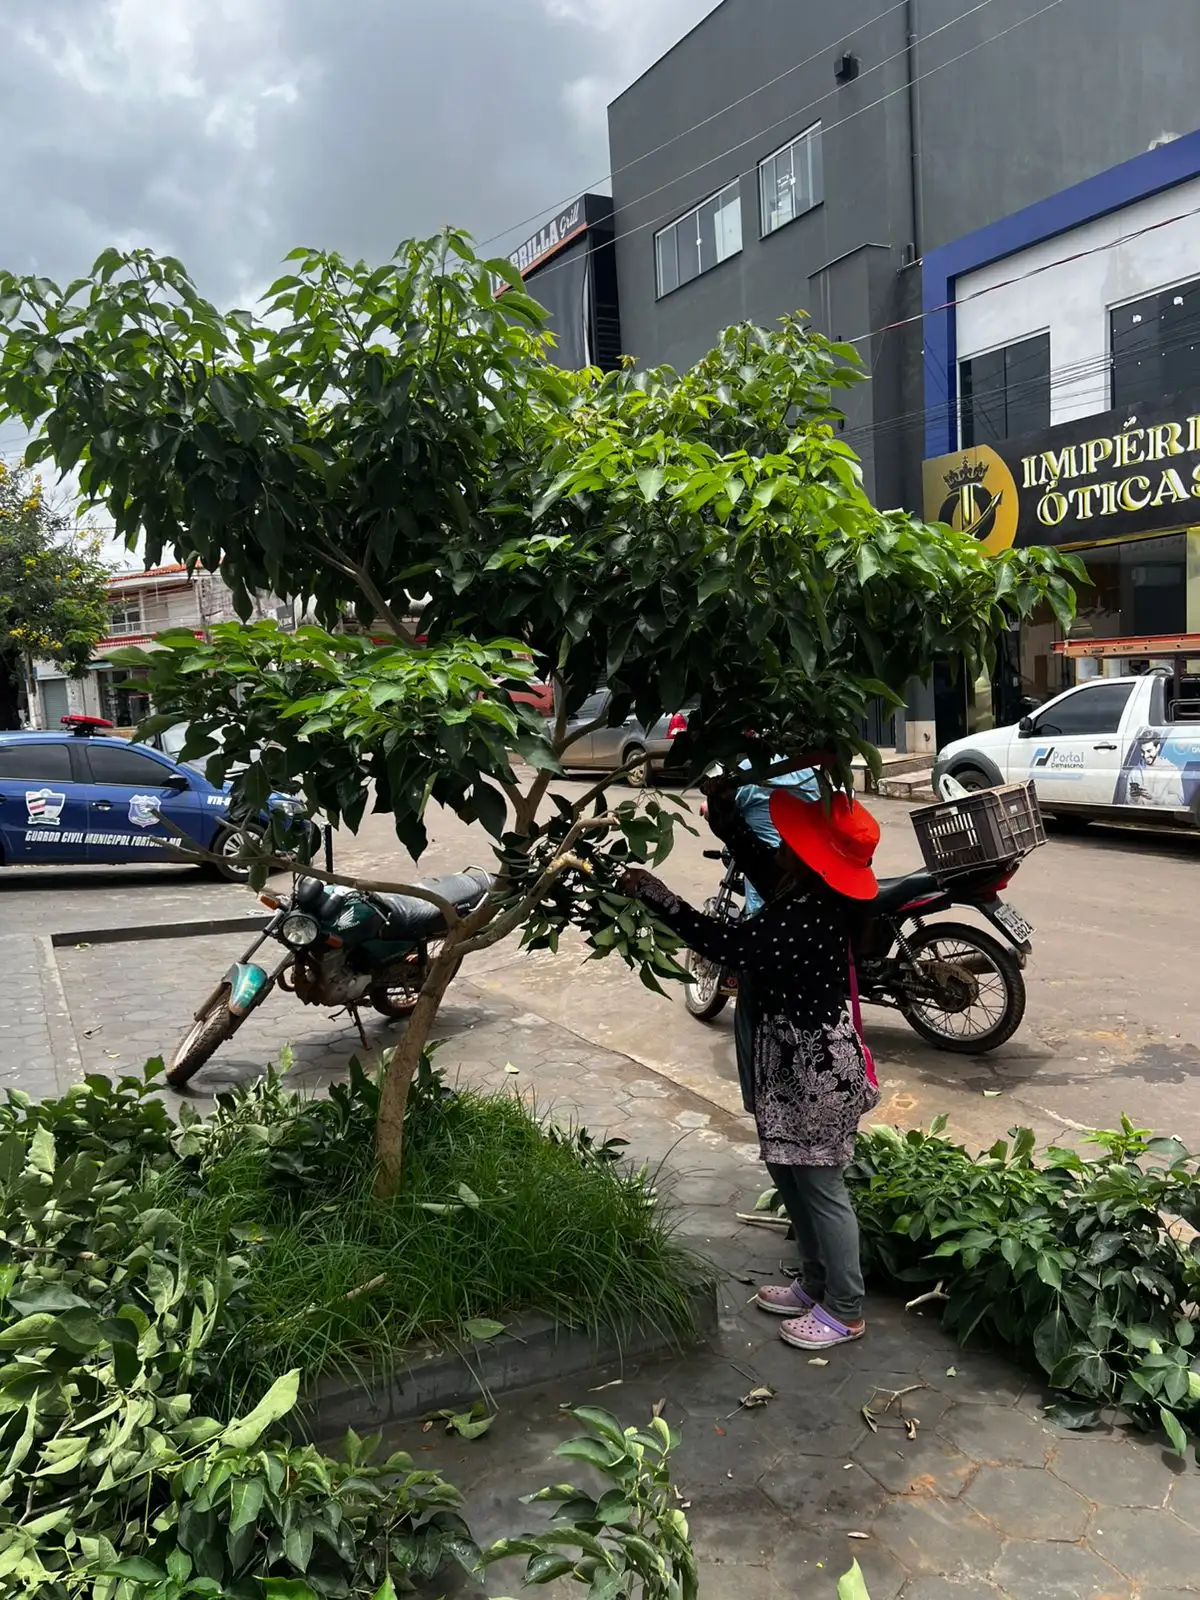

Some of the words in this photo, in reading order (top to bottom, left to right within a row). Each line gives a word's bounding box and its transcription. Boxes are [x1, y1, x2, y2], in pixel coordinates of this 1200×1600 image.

[1053, 751, 1085, 763] Portal
[25, 830, 61, 842] GUARDA
[61, 831, 84, 843] CIVIL
[84, 833, 130, 846] MUNICIPAL
